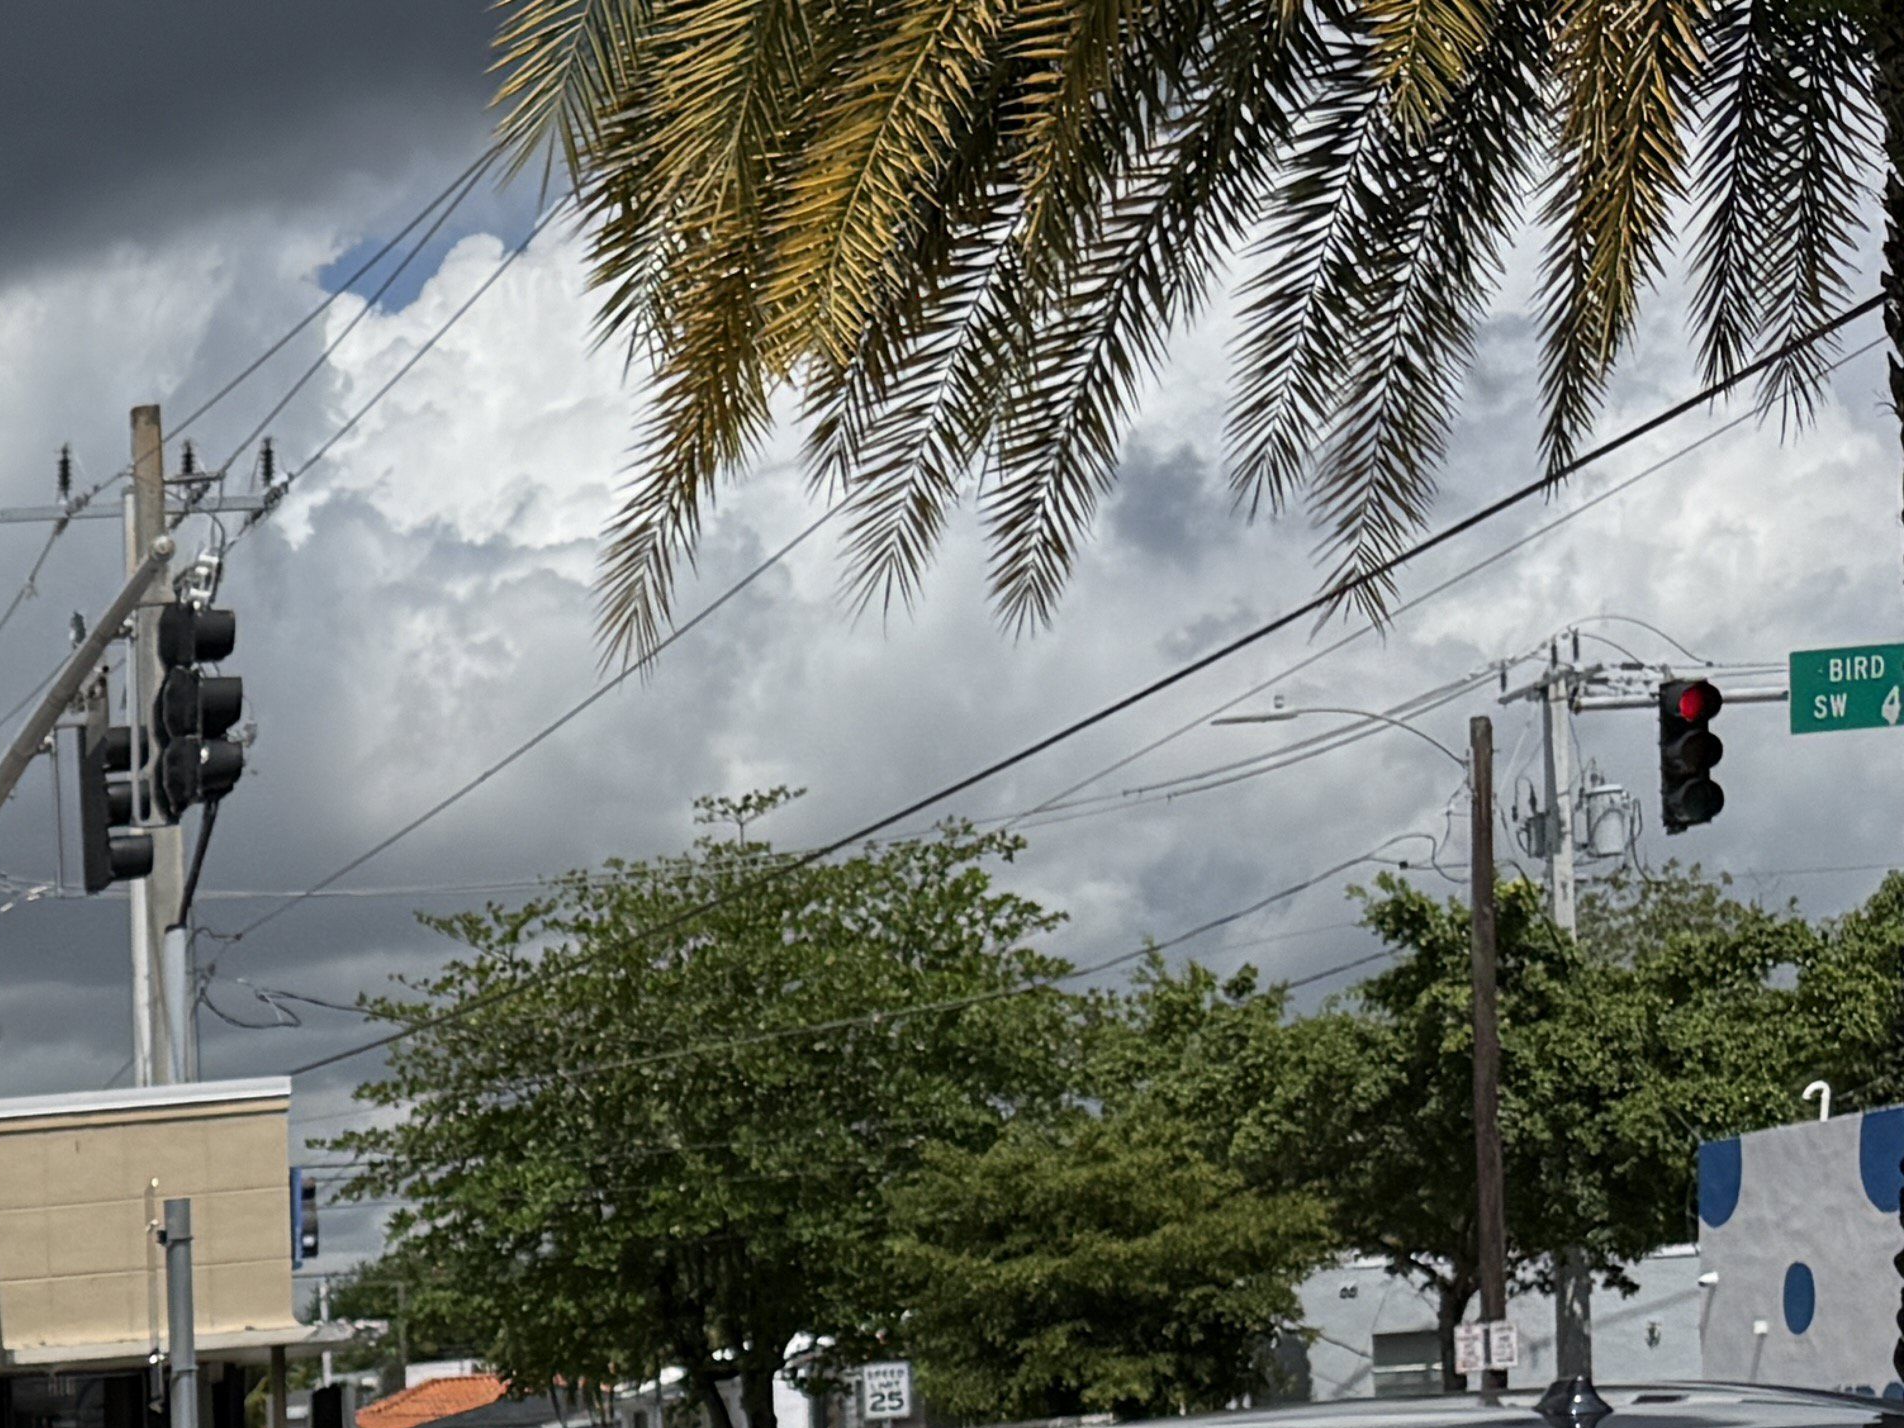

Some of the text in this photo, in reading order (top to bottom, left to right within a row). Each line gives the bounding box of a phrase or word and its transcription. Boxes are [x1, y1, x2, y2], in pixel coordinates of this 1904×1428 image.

[1829, 654, 1885, 683] BIRD
[1813, 692, 1848, 720] SW
[869, 1391, 905, 1412] 25
